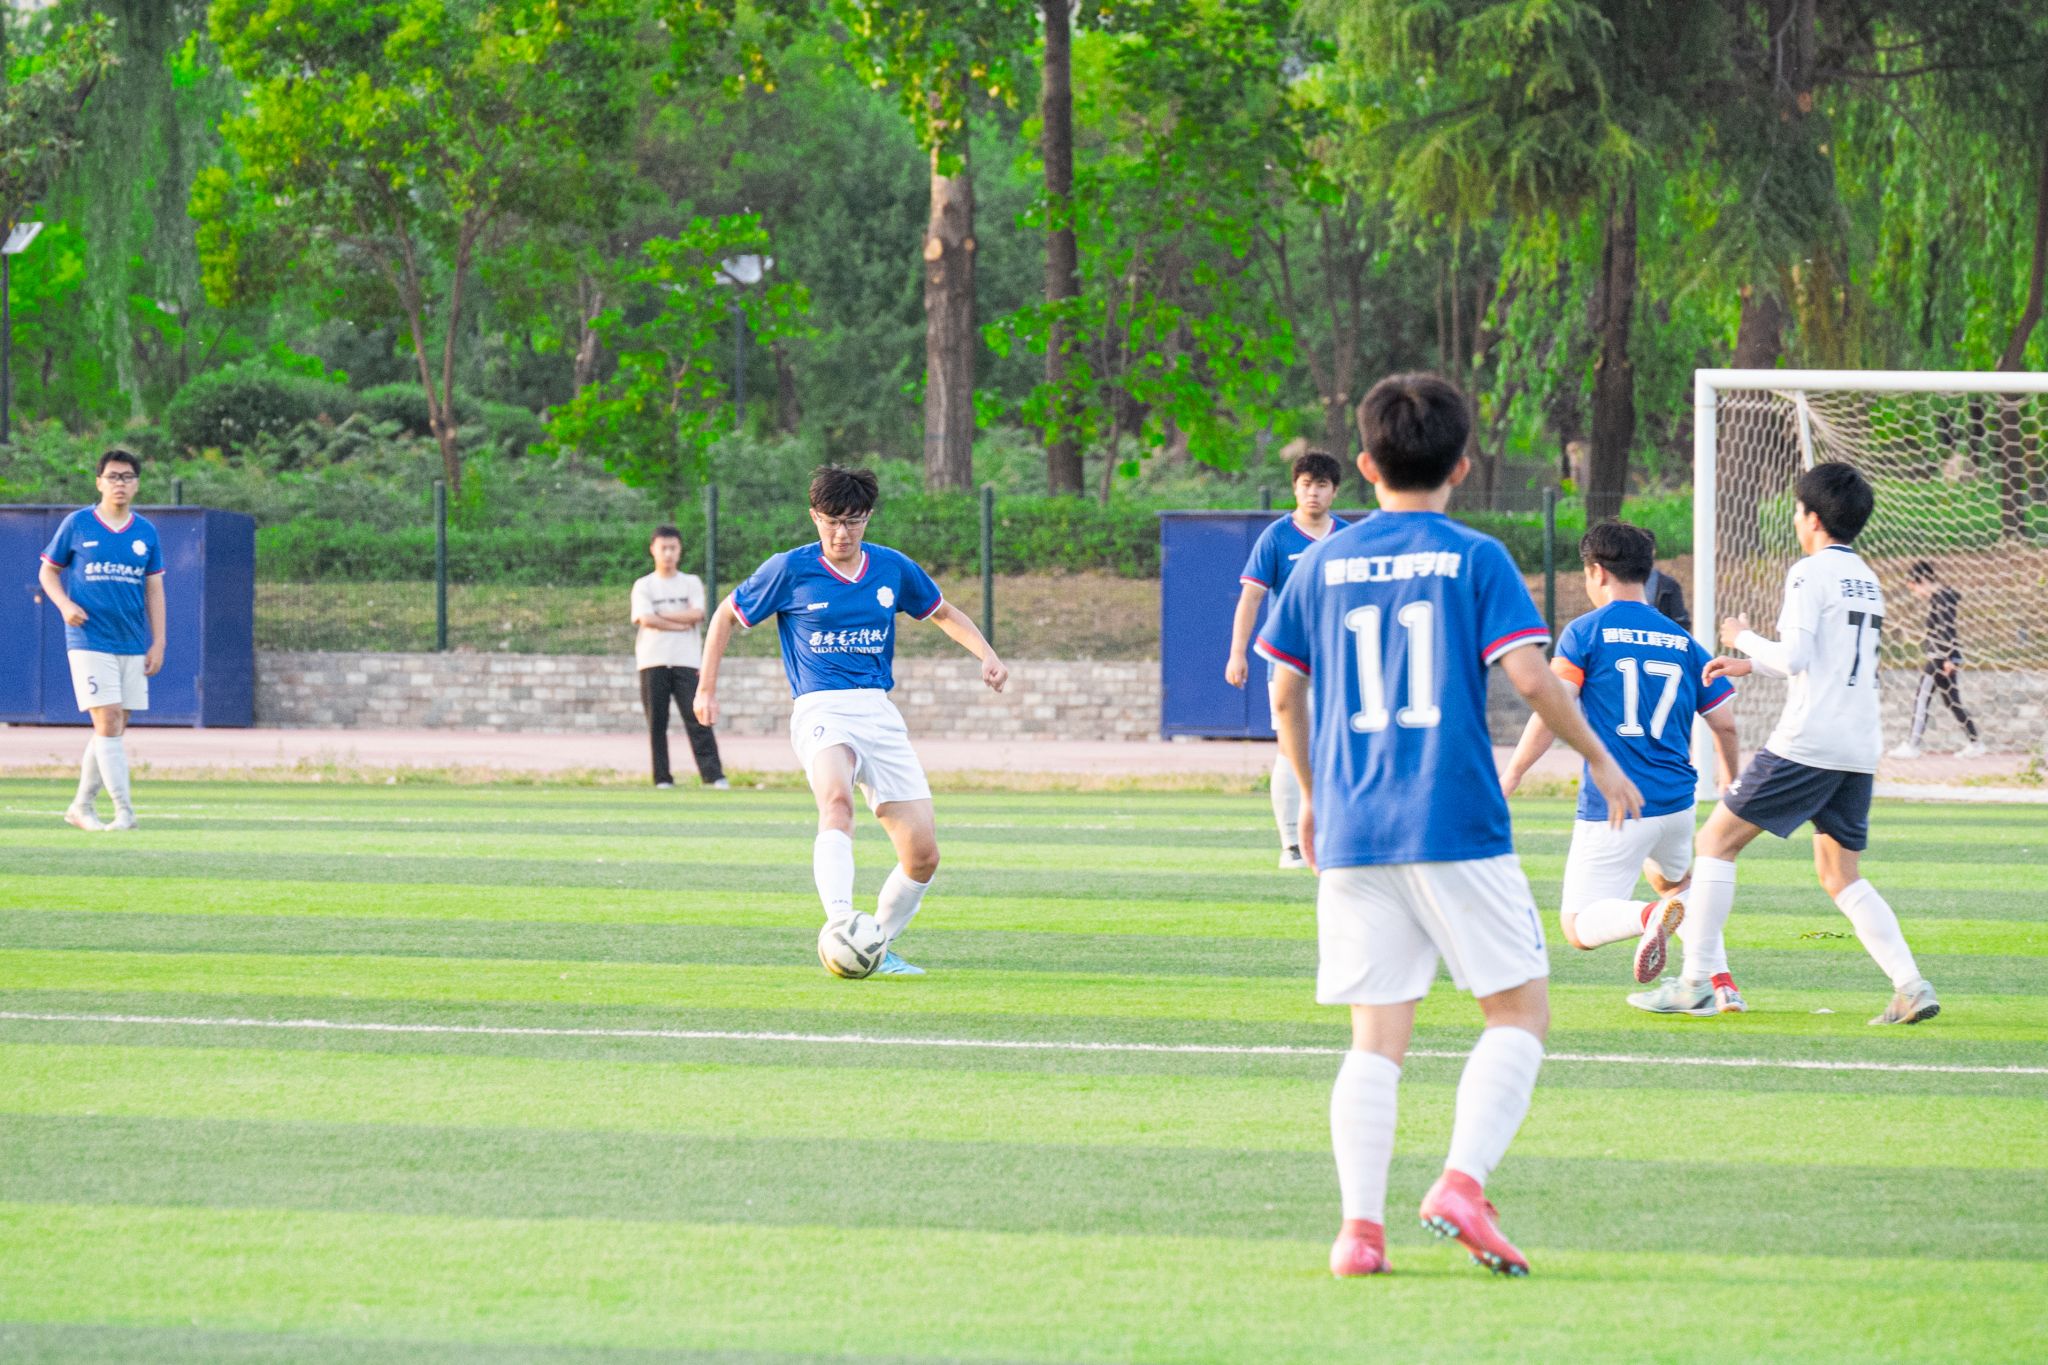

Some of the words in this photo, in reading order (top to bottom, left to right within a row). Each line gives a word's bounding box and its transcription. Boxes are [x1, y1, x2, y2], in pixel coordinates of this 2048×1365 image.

[1602, 628, 1689, 652] 通信工程学院
[87, 675, 98, 695] 5
[1344, 600, 1441, 734] 11
[1615, 657, 1684, 740] 17
